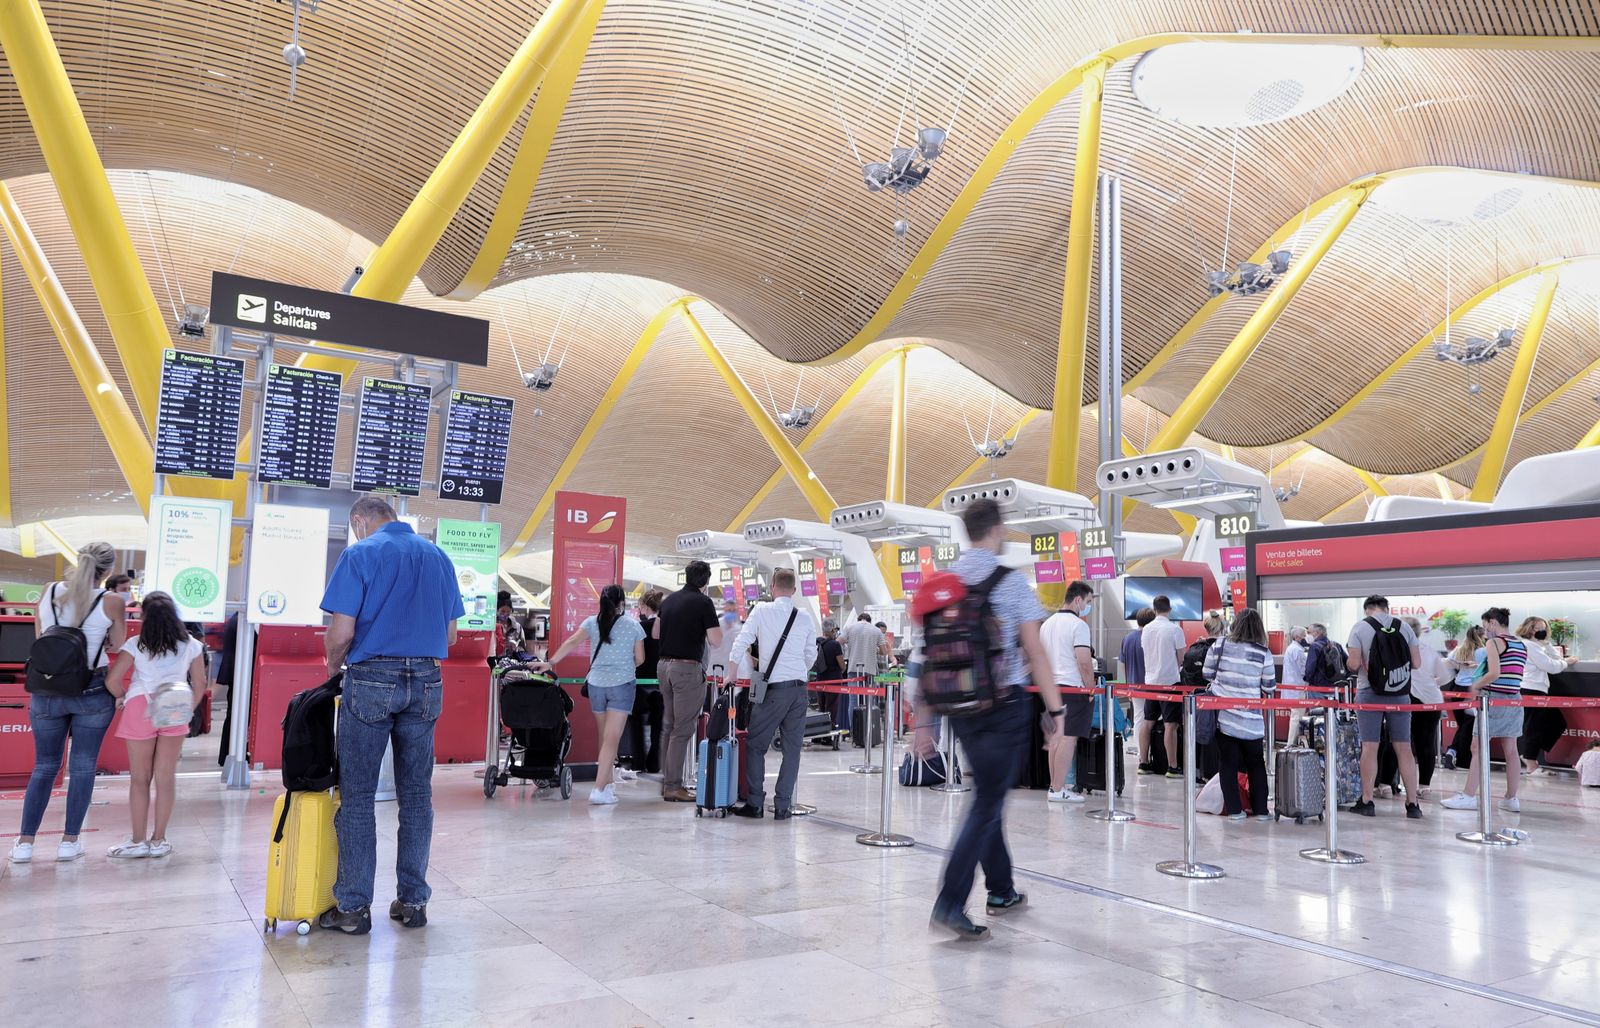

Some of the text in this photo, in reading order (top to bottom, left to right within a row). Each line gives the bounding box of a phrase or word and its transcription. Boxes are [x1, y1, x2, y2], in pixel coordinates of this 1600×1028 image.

[274, 301, 331, 320] Departures
[273, 313, 318, 331] Salidas
[180, 354, 214, 365] Facturación
[283, 368, 314, 378] Facturación
[378, 382, 406, 391] Facturación
[464, 394, 490, 403] Facturación
[458, 486, 484, 497] 13:33
[168, 510, 190, 518] 10%
[567, 509, 588, 523] IB
[1220, 516, 1250, 535] 810
[1085, 530, 1106, 546] 811
[1035, 536, 1055, 552] 812
[901, 551, 916, 563] 814
[938, 547, 954, 560] 813
[1266, 551, 1285, 559] Venta
[1297, 548, 1322, 557] billetes
[800, 561, 813, 573] 816
[828, 558, 842, 570] 815
[1266, 559, 1303, 568] Ticket sales
[722, 570, 731, 580] 818
[744, 568, 754, 578] 817
[1391, 606, 1426, 616] ERIA
[0, 724, 32, 732] ERIA
[1446, 720, 1458, 728] IB
[1562, 728, 1600, 738] BERIA
